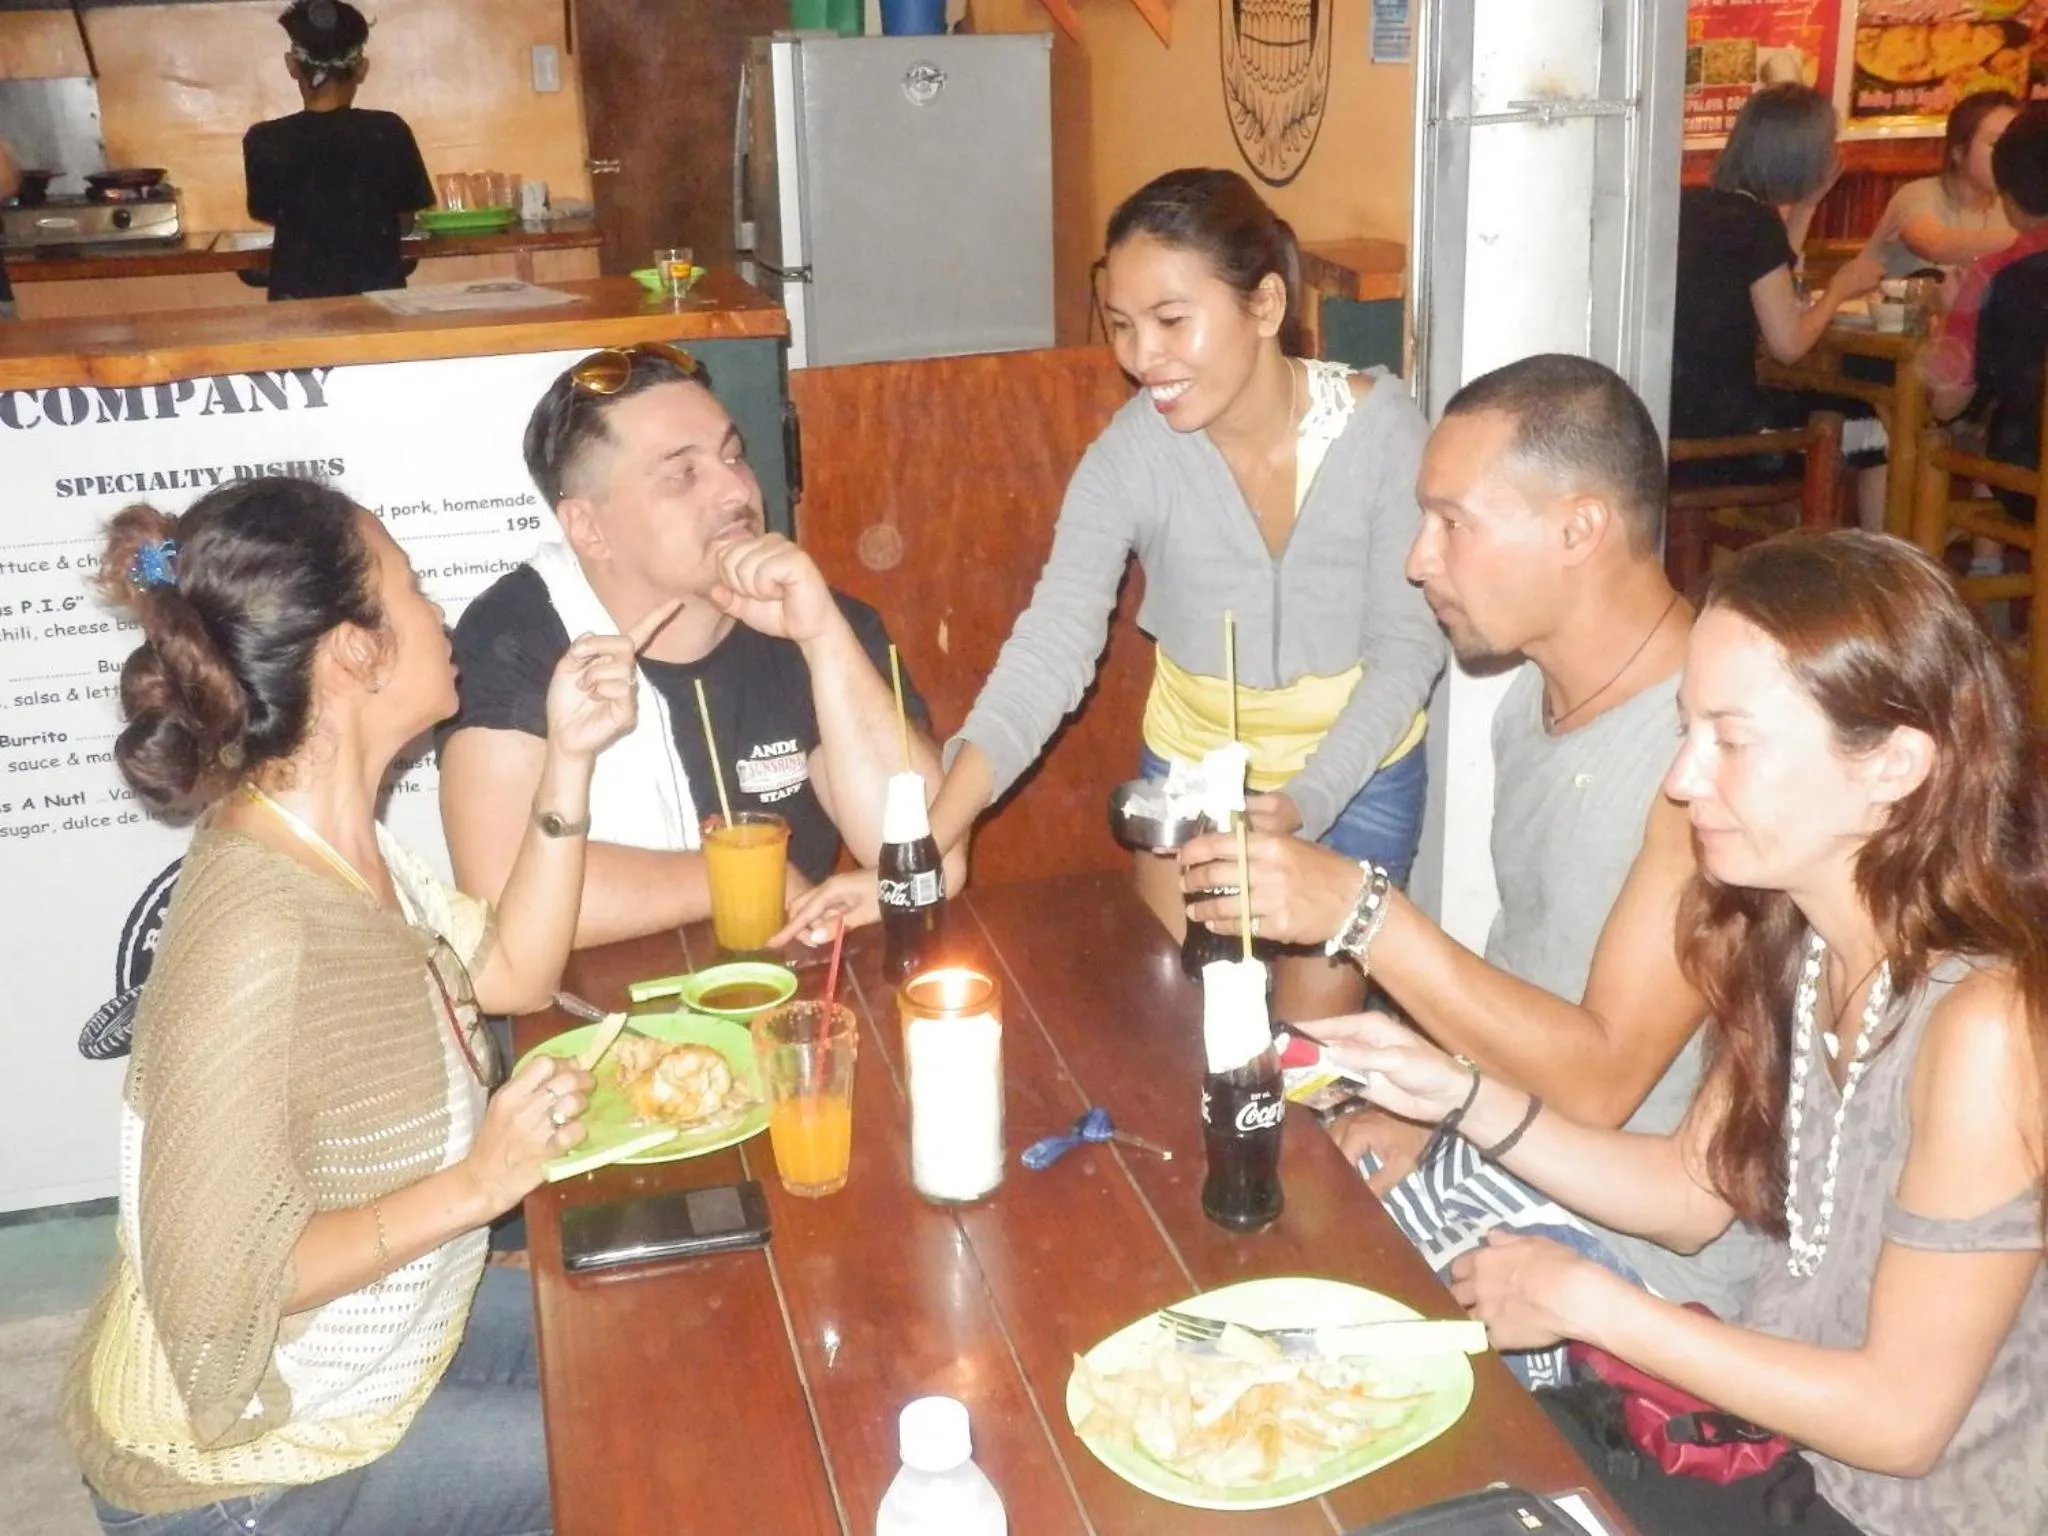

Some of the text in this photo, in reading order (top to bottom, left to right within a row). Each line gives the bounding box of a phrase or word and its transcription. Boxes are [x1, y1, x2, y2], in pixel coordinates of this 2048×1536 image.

[0, 365, 334, 430] COMPANY
[56, 457, 345, 498] SPECIALTY DISHES
[391, 499, 438, 521] pork,
[442, 492, 537, 512] homemade
[506, 516, 541, 532] 195
[56, 555, 70, 570] &
[44, 622, 110, 638] cheese
[14, 691, 61, 707] salsa
[66, 687, 79, 701] &
[0, 731, 68, 748] Burrito
[751, 738, 799, 760] ANDI
[8, 757, 61, 772] sauce
[67, 752, 80, 765] &
[22, 797, 36, 811] A
[0, 822, 57, 839] sugar,
[62, 815, 111, 830] dulce
[117, 810, 140, 825] de
